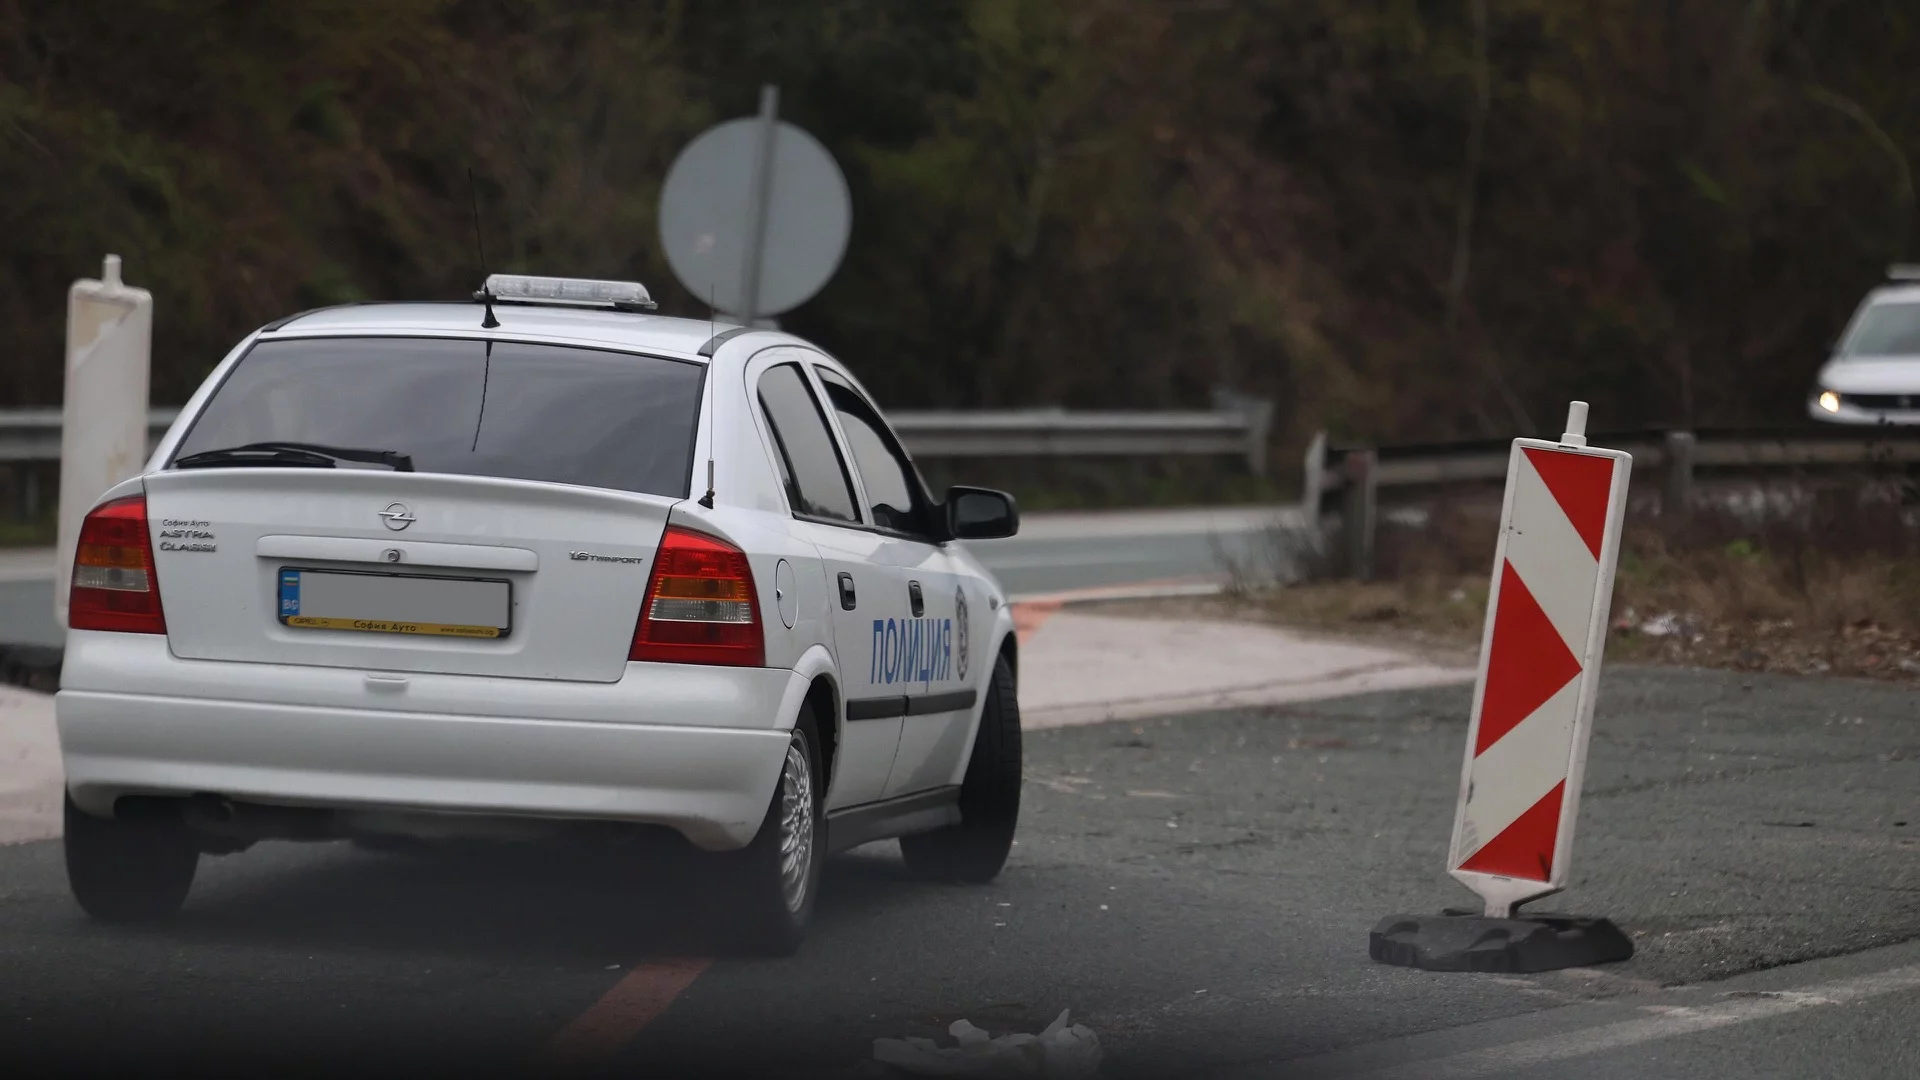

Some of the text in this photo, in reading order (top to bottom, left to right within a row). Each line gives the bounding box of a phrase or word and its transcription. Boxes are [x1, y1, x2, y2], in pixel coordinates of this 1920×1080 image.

[160, 529, 214, 539] ASTRA
[589, 555, 642, 564] TWINPORT
[283, 599, 299, 610] BG
[354, 620, 417, 632] София Ауто
[871, 618, 951, 693] ПОЛИЦИЯ
